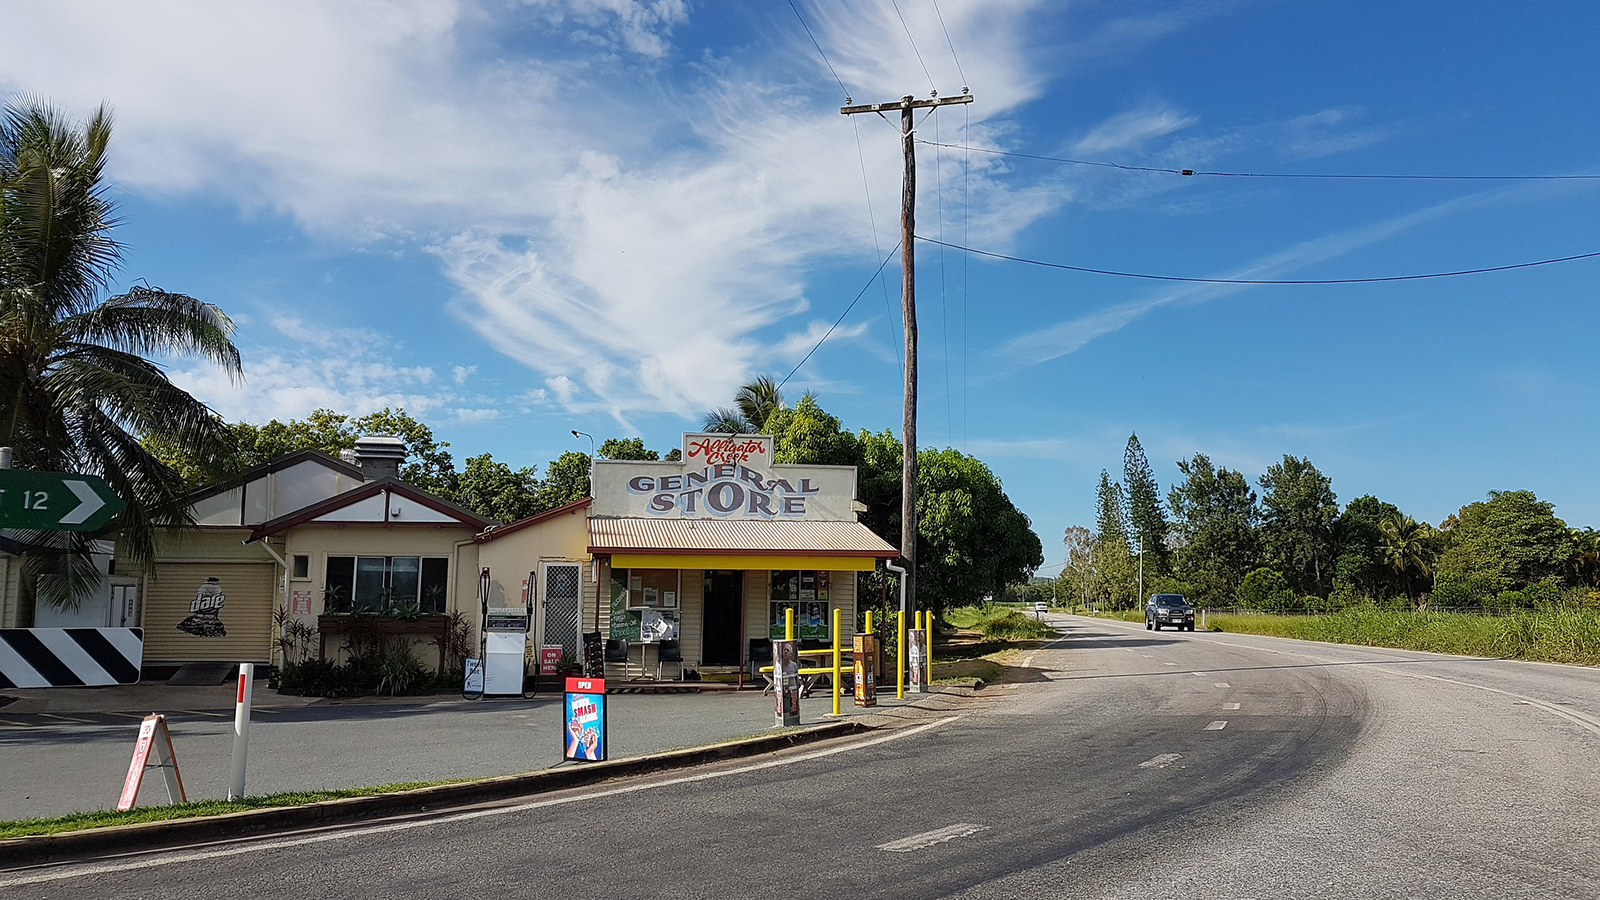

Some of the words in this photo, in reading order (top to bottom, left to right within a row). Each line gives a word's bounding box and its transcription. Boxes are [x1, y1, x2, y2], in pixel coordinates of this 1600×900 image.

[688, 438, 766, 458] Alligator
[706, 451, 749, 467] Creek
[627, 463, 820, 493] GENERAL
[23, 490, 48, 510] 12
[649, 481, 807, 516] STORE
[577, 681, 592, 690] OPEN
[573, 703, 597, 719] SMASH
